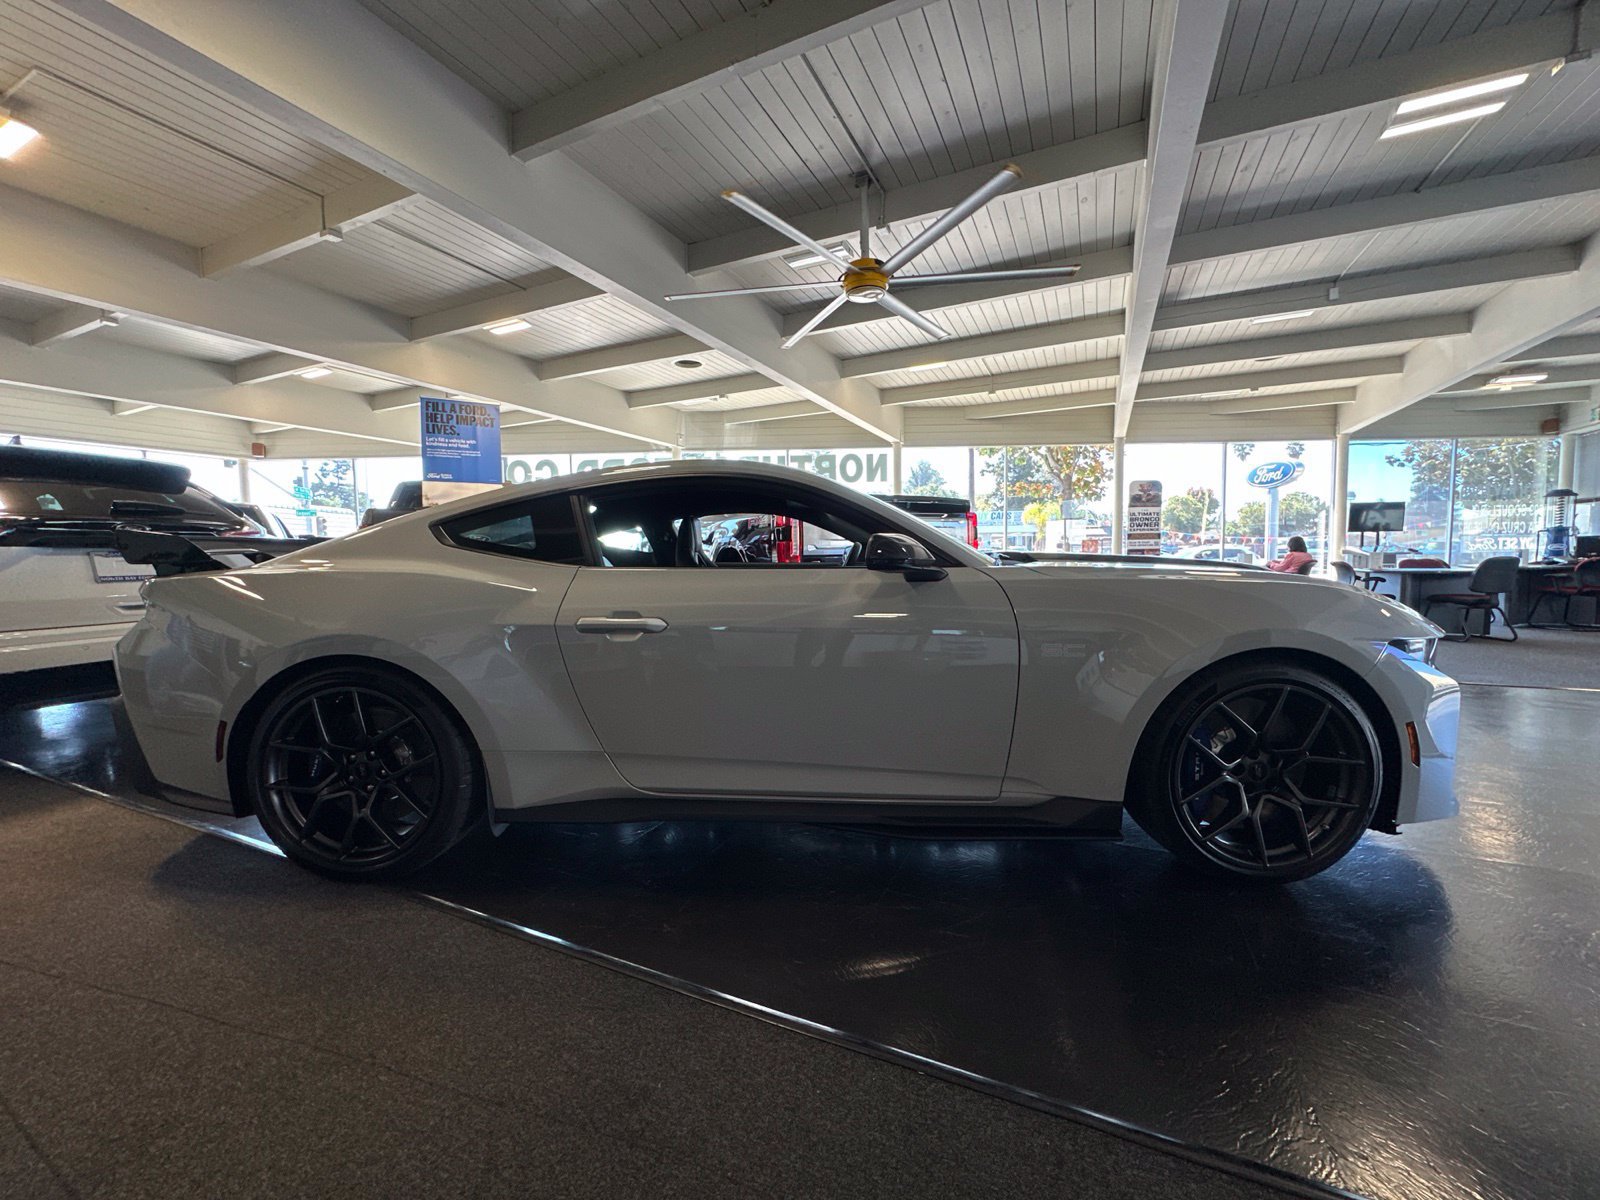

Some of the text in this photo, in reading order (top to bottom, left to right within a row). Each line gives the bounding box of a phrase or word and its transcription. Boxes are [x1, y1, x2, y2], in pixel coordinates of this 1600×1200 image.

[425, 400, 491, 417] FILL A FORD.
[425, 412, 496, 428] HELP IMPACT
[425, 423, 460, 436] LIVES.
[1253, 464, 1285, 483] Ford
